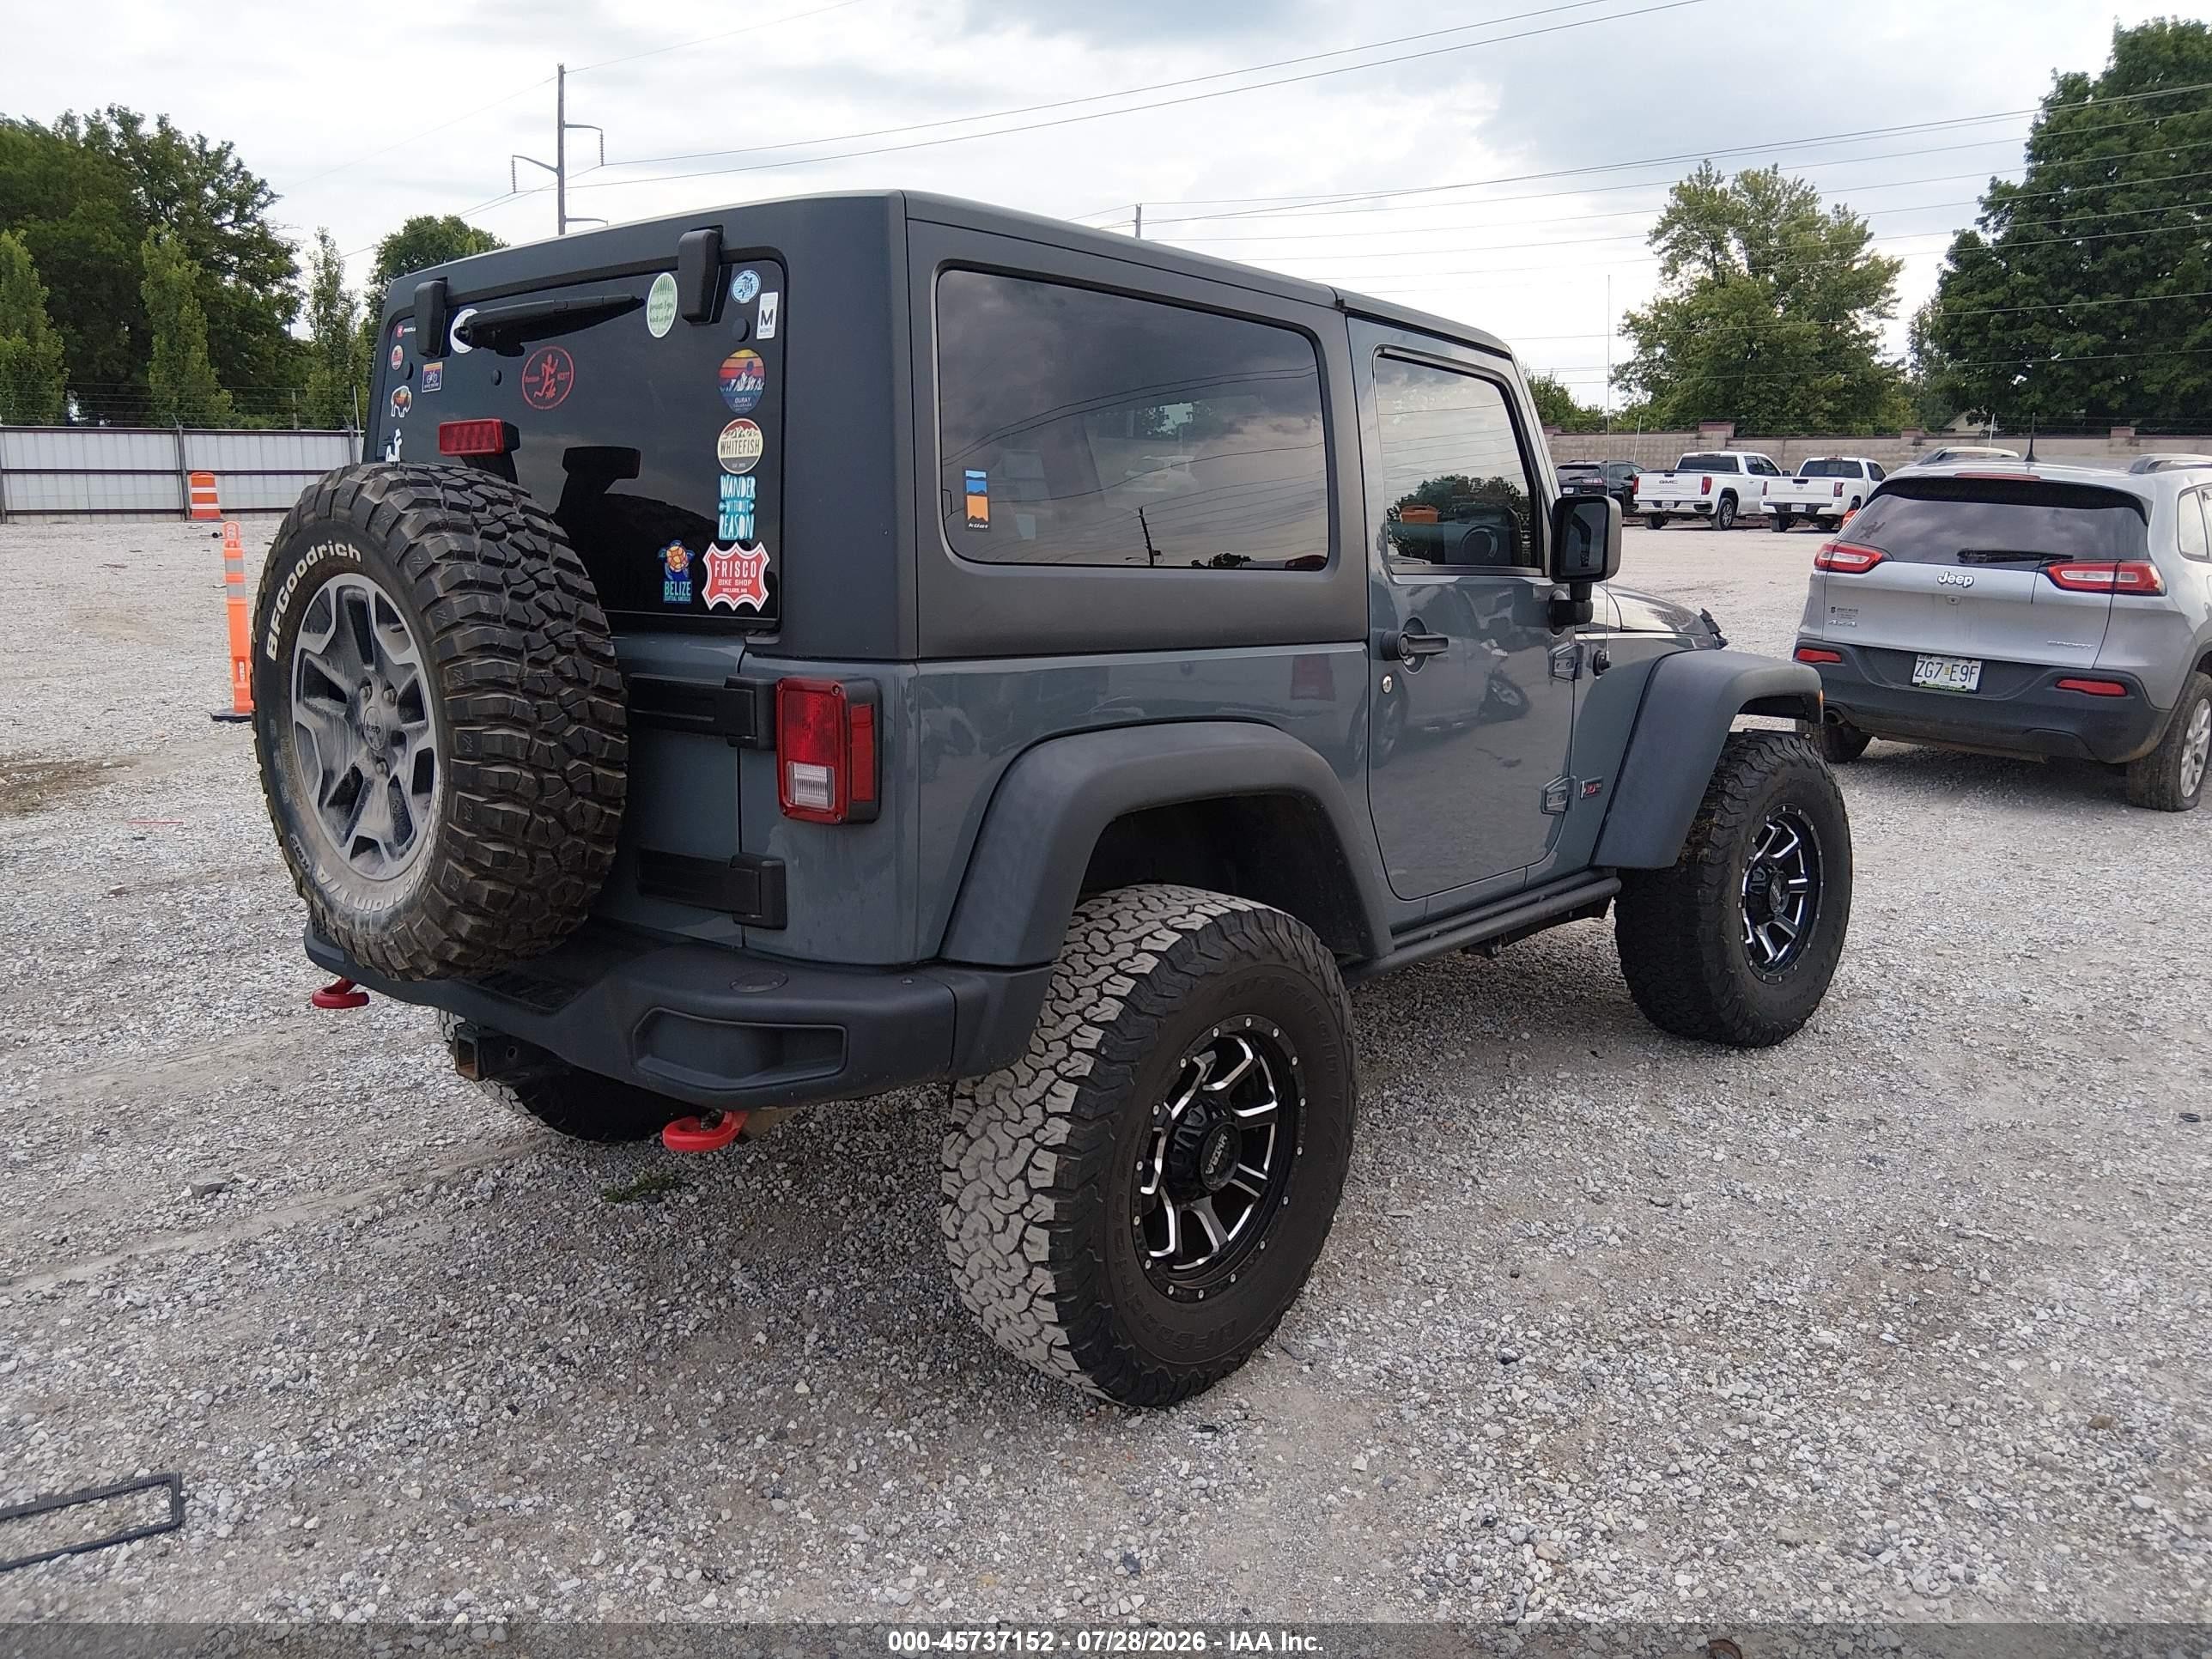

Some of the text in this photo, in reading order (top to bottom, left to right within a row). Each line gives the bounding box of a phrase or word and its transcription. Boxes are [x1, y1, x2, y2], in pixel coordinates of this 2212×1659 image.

[760, 308, 775, 326] M
[721, 439, 760, 455] WHITEFISH
[720, 474, 756, 500] WANDER
[726, 501, 750, 513] WITHOUT
[718, 514, 755, 540] REASON
[714, 560, 757, 578] FRISCO
[718, 578, 752, 586] BIKE SHOP
[1937, 571, 1975, 588] Jeep
[664, 581, 692, 597] BELIZE
[266, 539, 362, 661] BFGoodrich
[1914, 659, 1979, 684] ZG7 E9F
[1205, 1133, 1228, 1175] ULTRA
